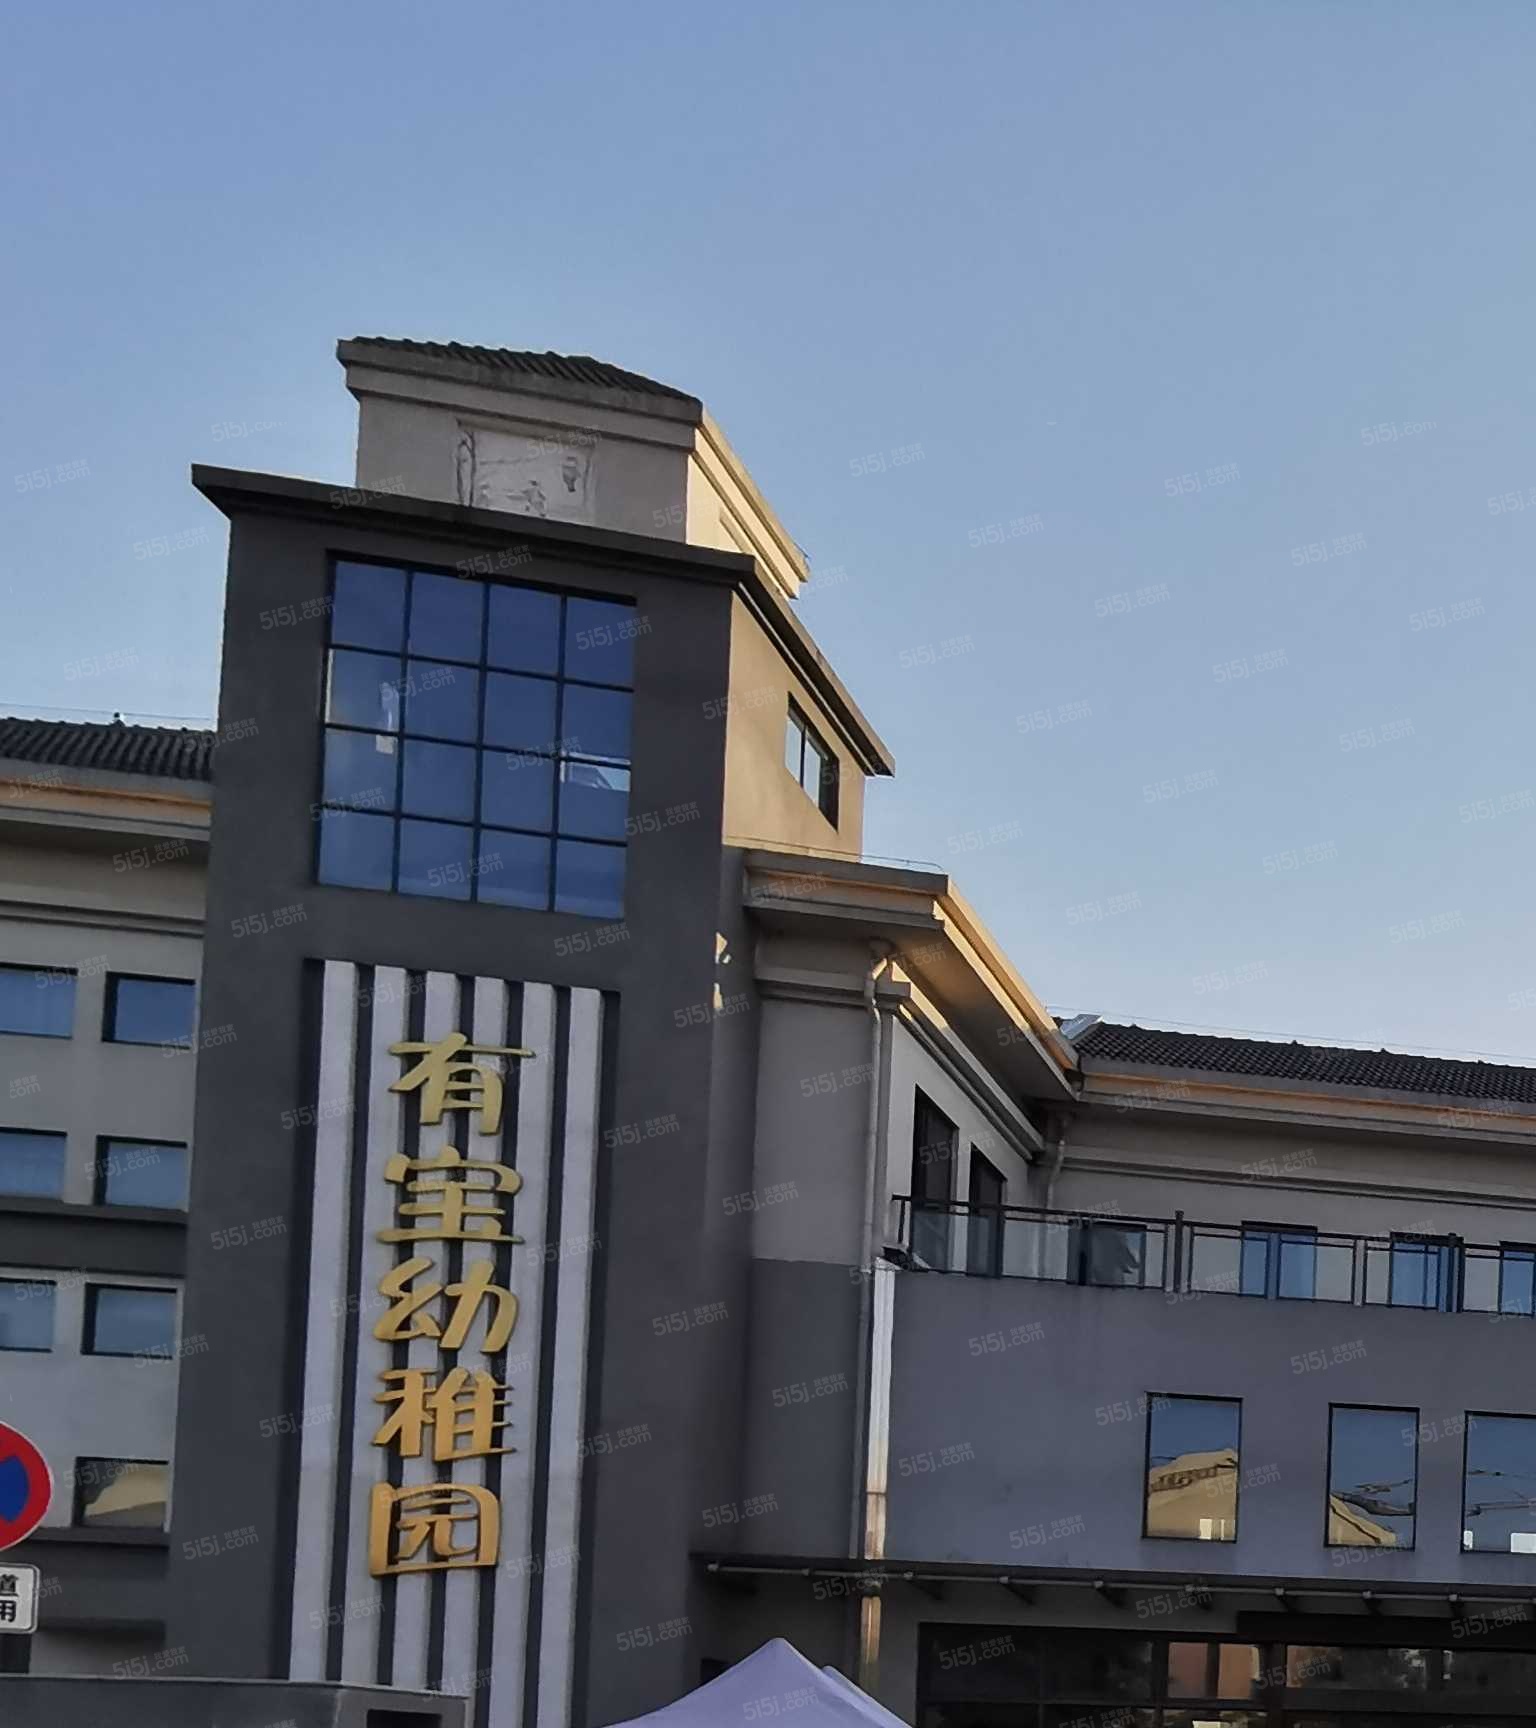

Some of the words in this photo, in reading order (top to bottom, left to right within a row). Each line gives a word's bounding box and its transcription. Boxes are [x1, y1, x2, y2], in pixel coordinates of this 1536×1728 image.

[369, 1031, 536, 1577] 有宝幼稚园
